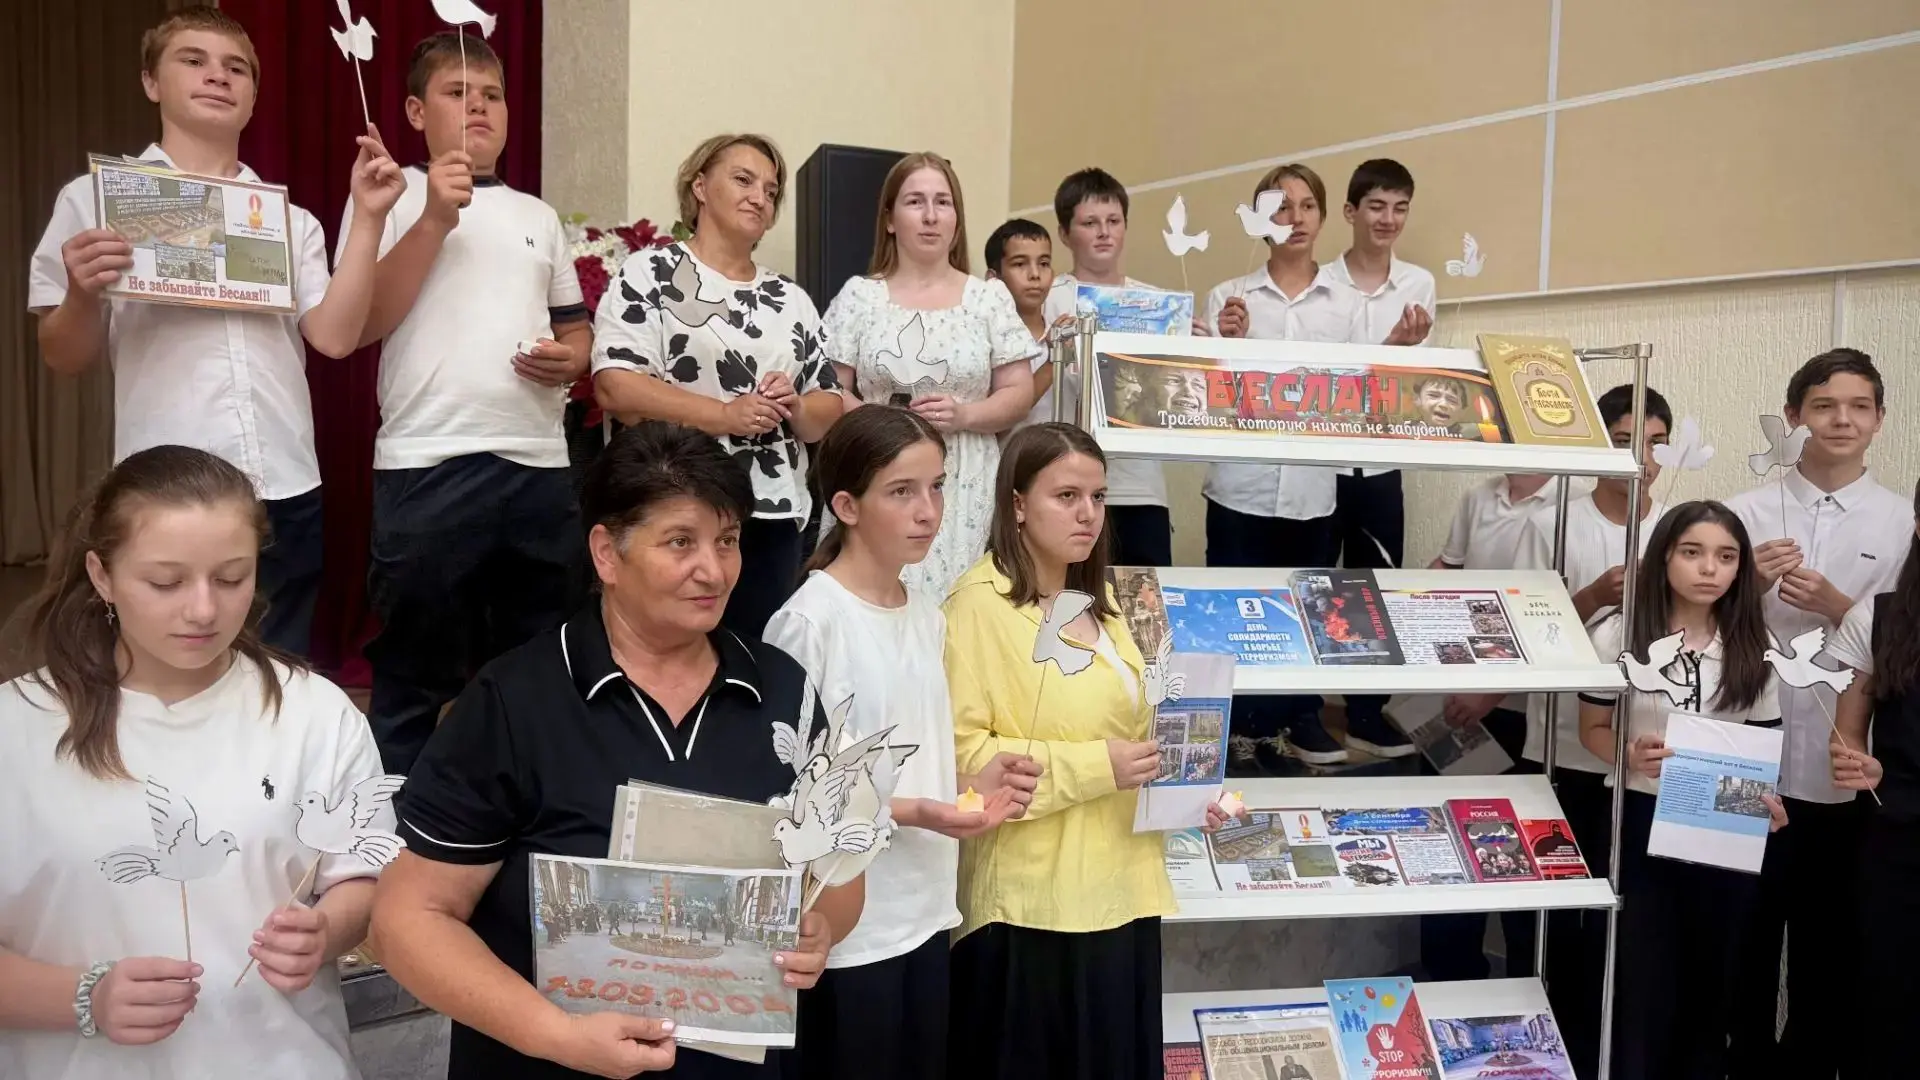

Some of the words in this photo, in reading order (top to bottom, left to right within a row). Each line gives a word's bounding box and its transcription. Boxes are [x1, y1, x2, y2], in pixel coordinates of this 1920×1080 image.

[526, 236, 535, 248] H
[127, 275, 146, 290] Не
[149, 278, 216, 298] забывайте
[218, 284, 271, 303] Беслан!!!
[1204, 370, 1400, 414] БЕСЛАН
[1157, 410, 1233, 430] Трагедия,
[1237, 417, 1307, 434] которую
[1311, 421, 1362, 434] никто
[1366, 423, 1383, 434] не
[1387, 420, 1464, 440] забудет...
[1244, 599, 1256, 613] 3
[1246, 623, 1268, 632] ДЕНЬ
[1227, 632, 1292, 642] СОЛИДАРНОСТИ
[1243, 643, 1251, 651] В
[1252, 643, 1282, 652] БОРЬБЕ
[1241, 653, 1298, 662] ТЕРРОРИЗМОМ
[1357, 839, 1381, 849] МЫ
[1234, 881, 1249, 891] Не
[1250, 880, 1293, 891] забывайте
[1379, 1050, 1404, 1063] STOP
[1369, 1067, 1433, 1080] РРОРИЗМУ!!!
